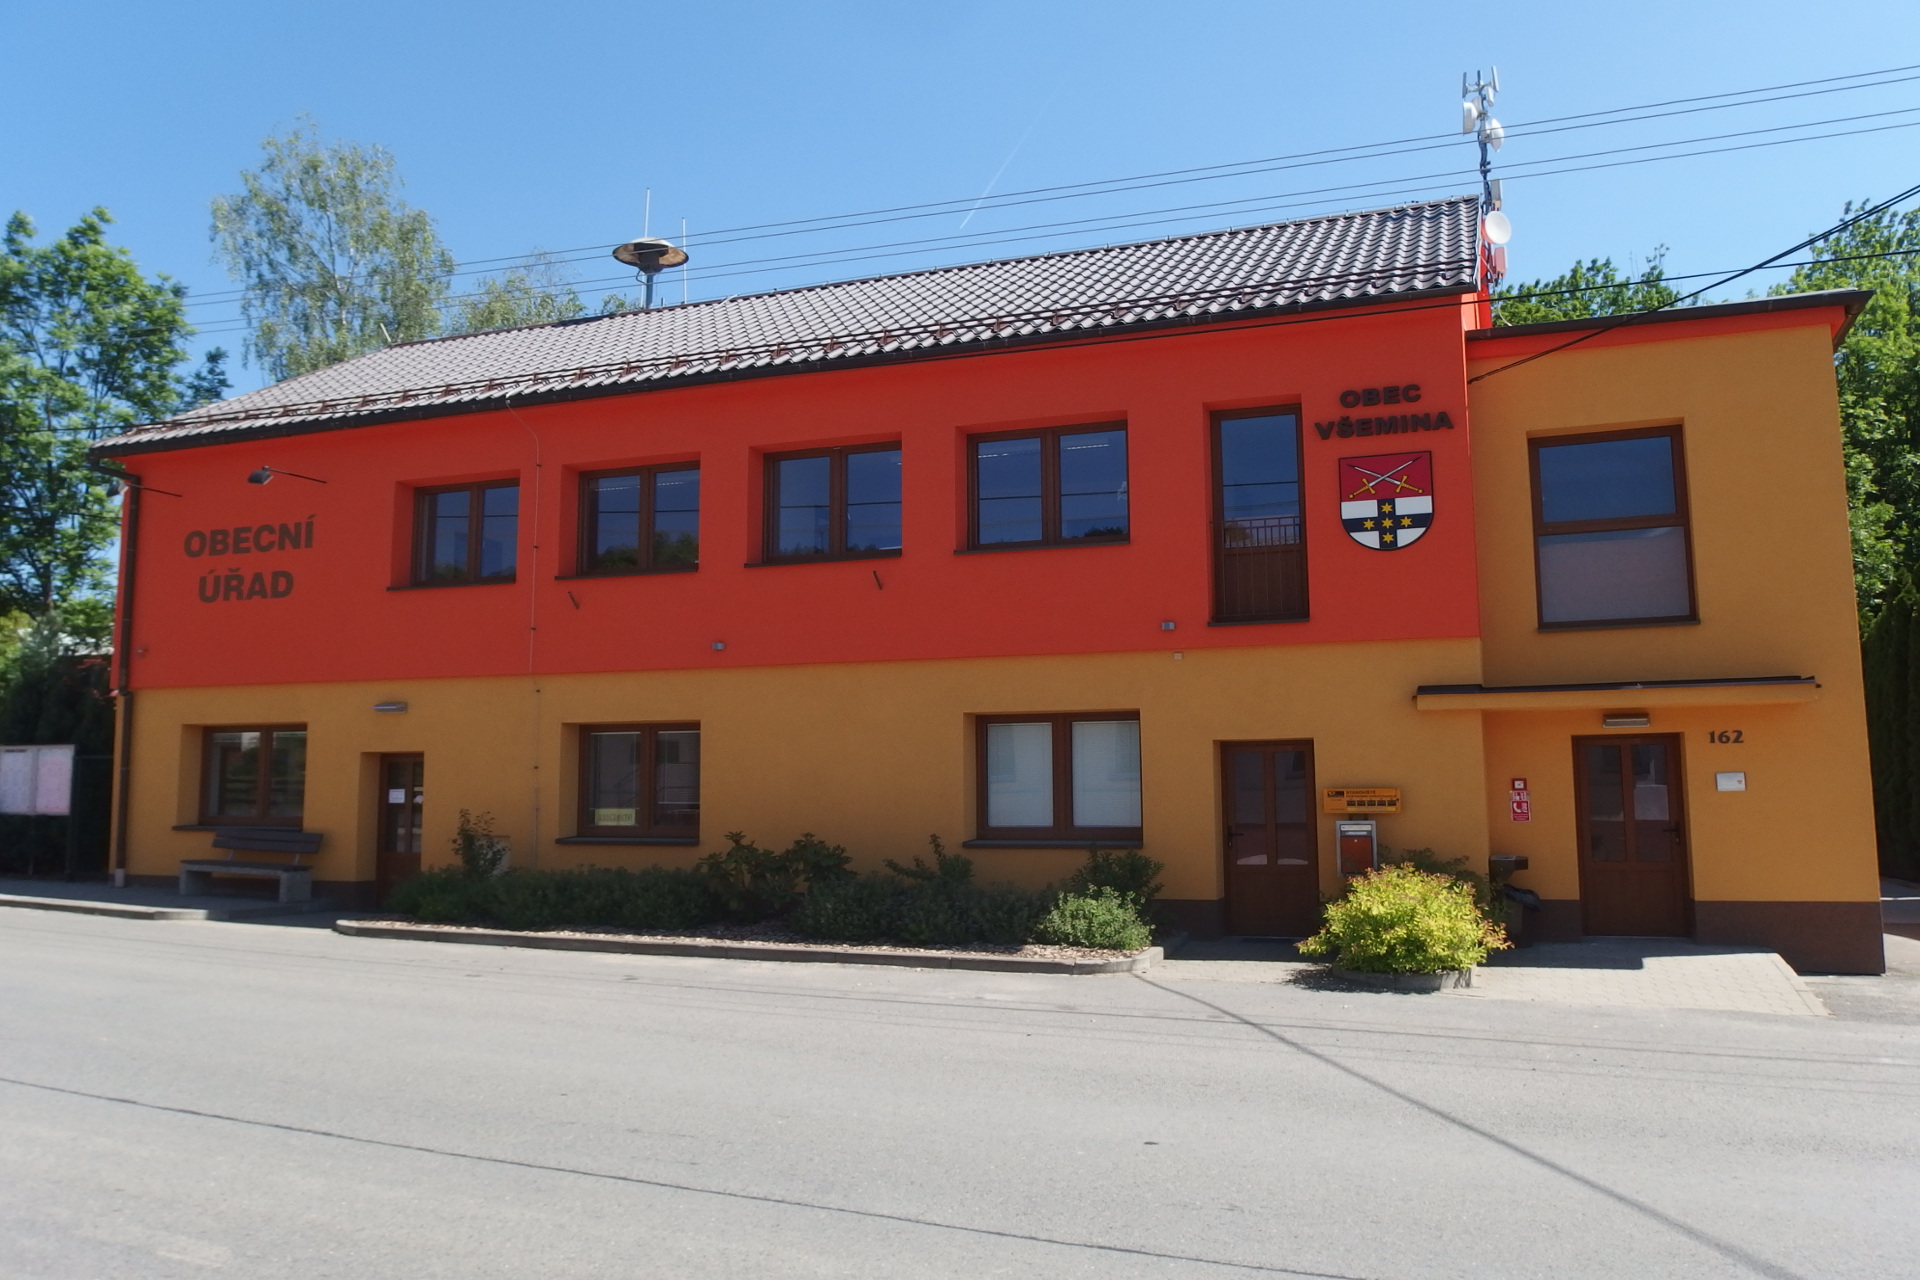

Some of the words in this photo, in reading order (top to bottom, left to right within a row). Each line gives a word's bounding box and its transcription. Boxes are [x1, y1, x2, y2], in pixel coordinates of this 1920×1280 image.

[1339, 384, 1422, 409] OBEC
[1314, 411, 1454, 440] VŠEMINA
[184, 513, 317, 558] OBECNÍ
[198, 567, 294, 603] ÚŘAD
[1708, 729, 1744, 744] 162
